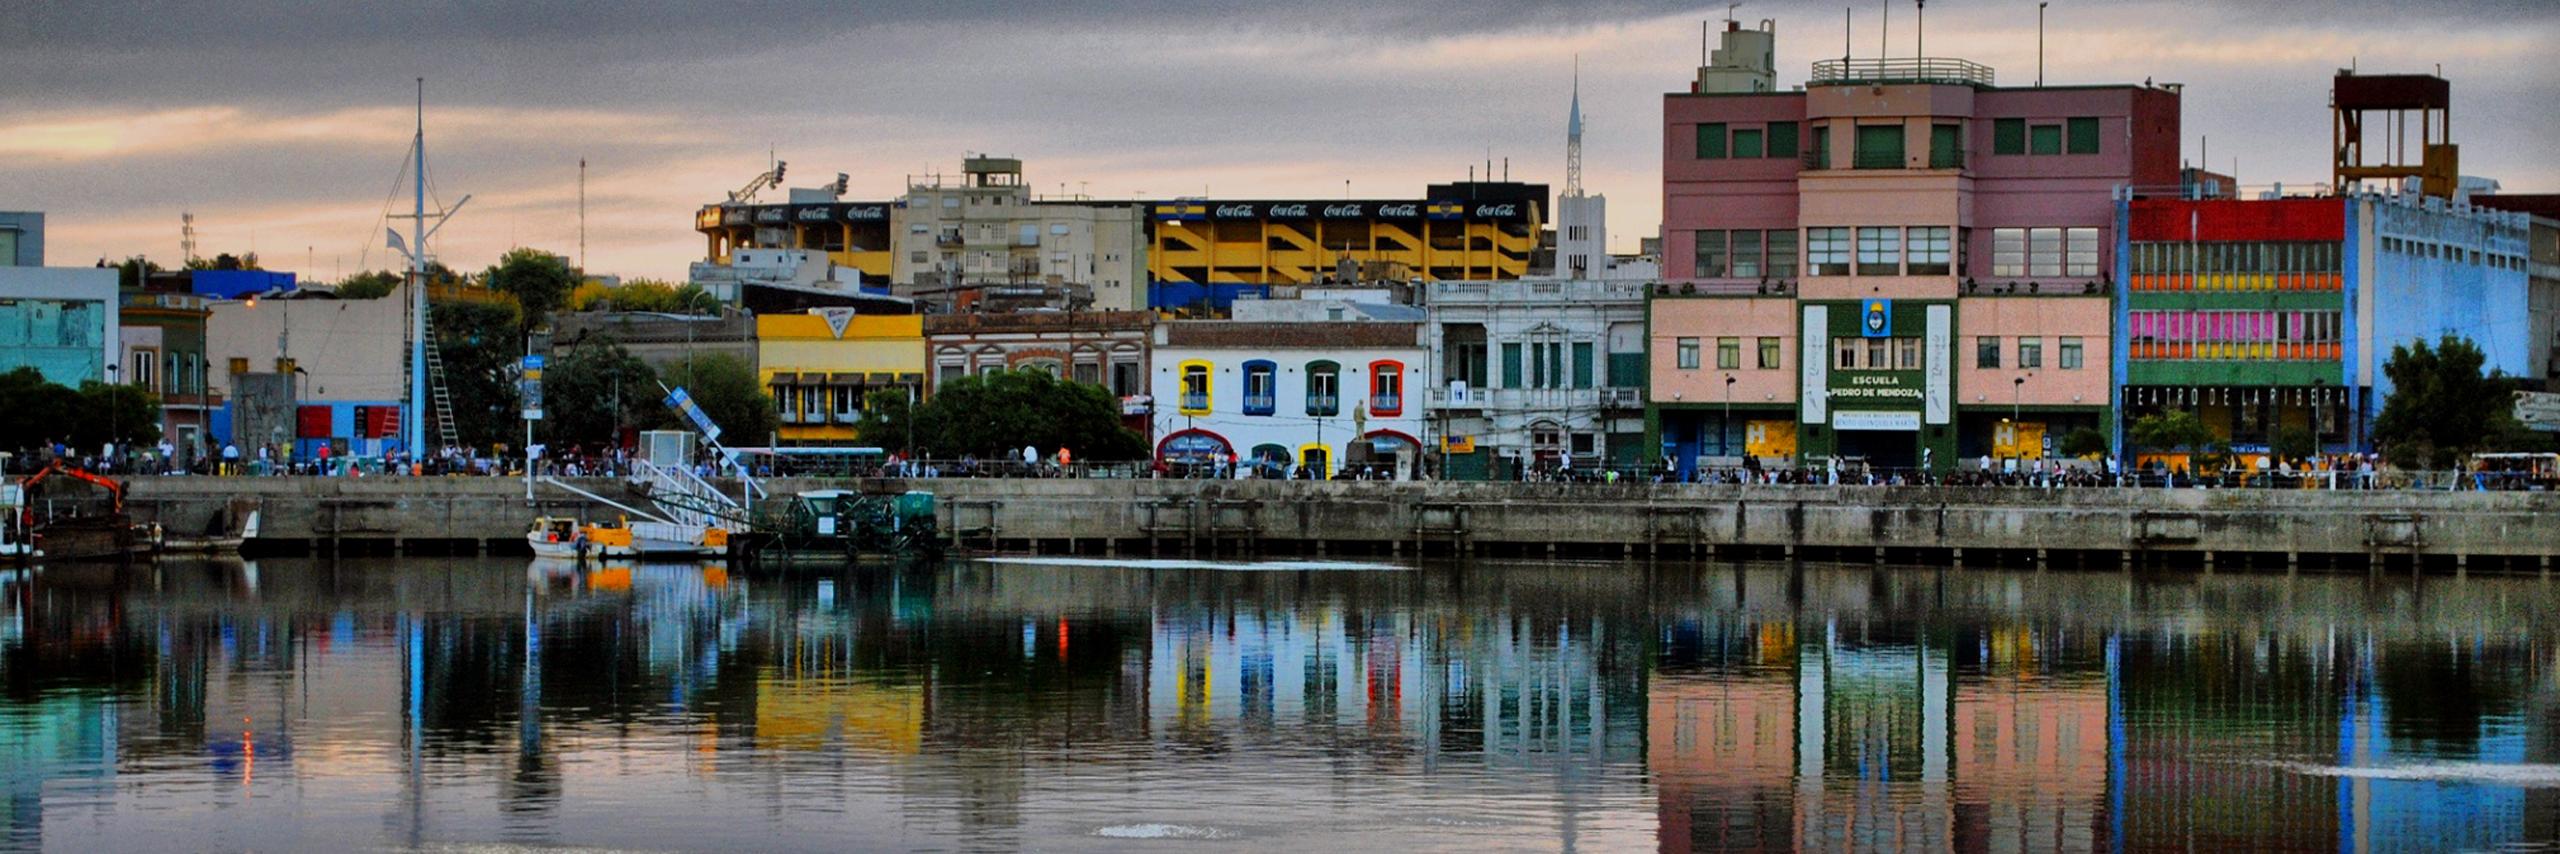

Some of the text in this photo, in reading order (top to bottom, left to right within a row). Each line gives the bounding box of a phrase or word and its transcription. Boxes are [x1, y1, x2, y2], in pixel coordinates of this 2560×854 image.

[1852, 376, 1899, 385] ESCUELA
[1831, 388, 1919, 397] PEDRO DE MENDOZA
[2124, 387, 2345, 406] TEATRO DE LA RIBERA
